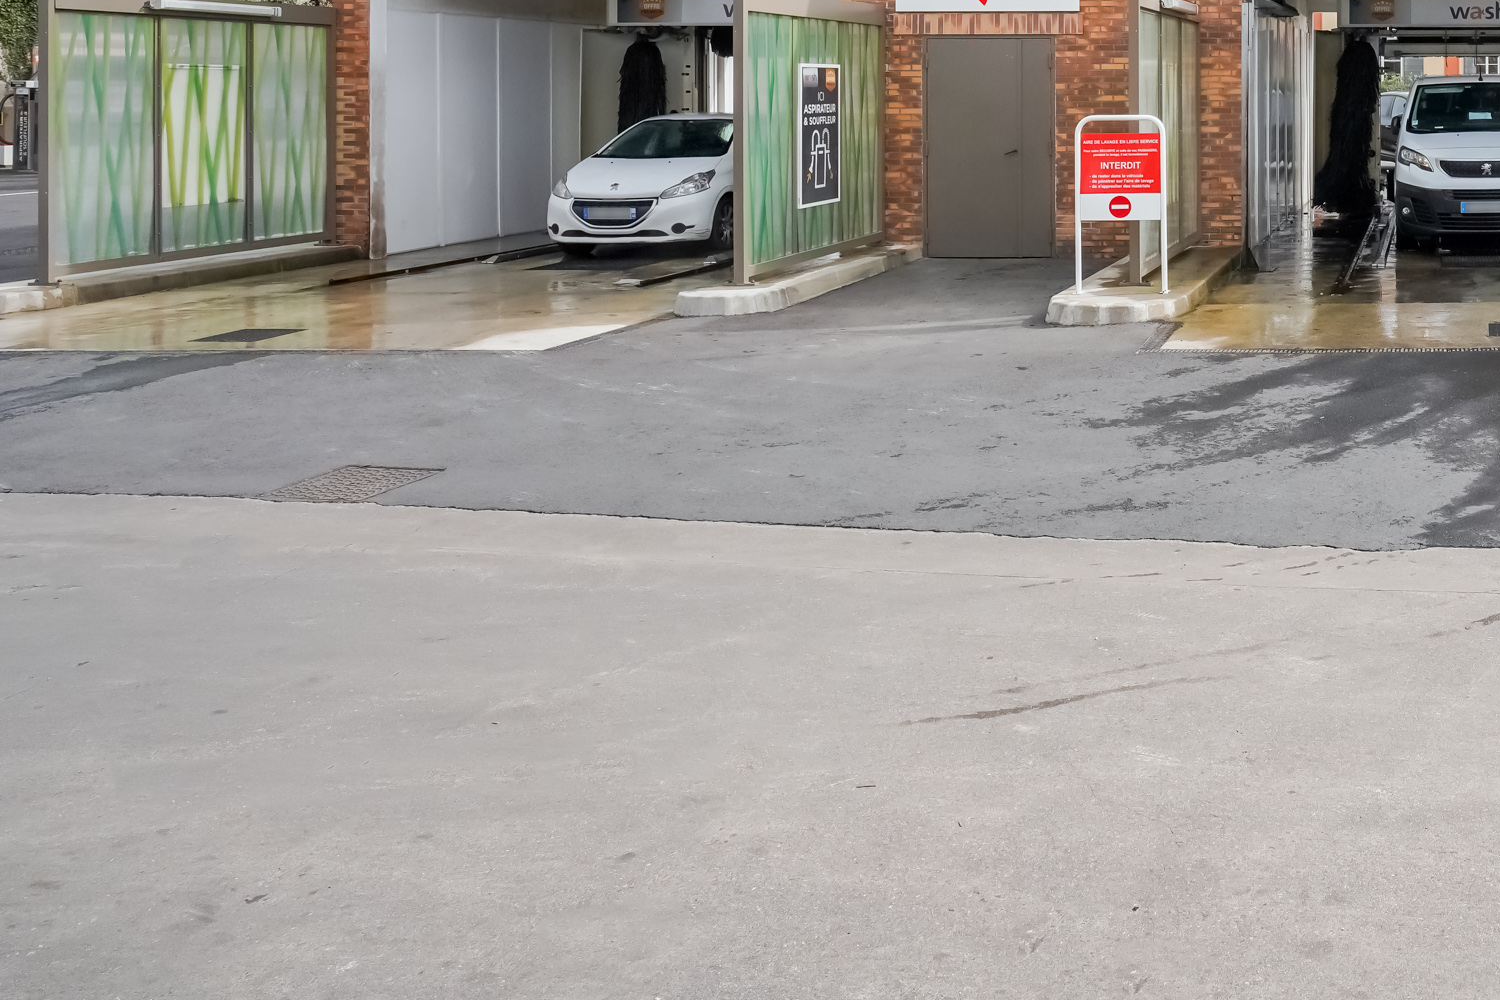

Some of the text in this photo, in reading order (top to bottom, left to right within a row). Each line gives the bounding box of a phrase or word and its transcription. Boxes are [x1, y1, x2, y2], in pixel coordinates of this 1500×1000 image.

[803, 103, 836, 114] ASPIRATEUR
[803, 115, 836, 126] & SOUFFLEUR
